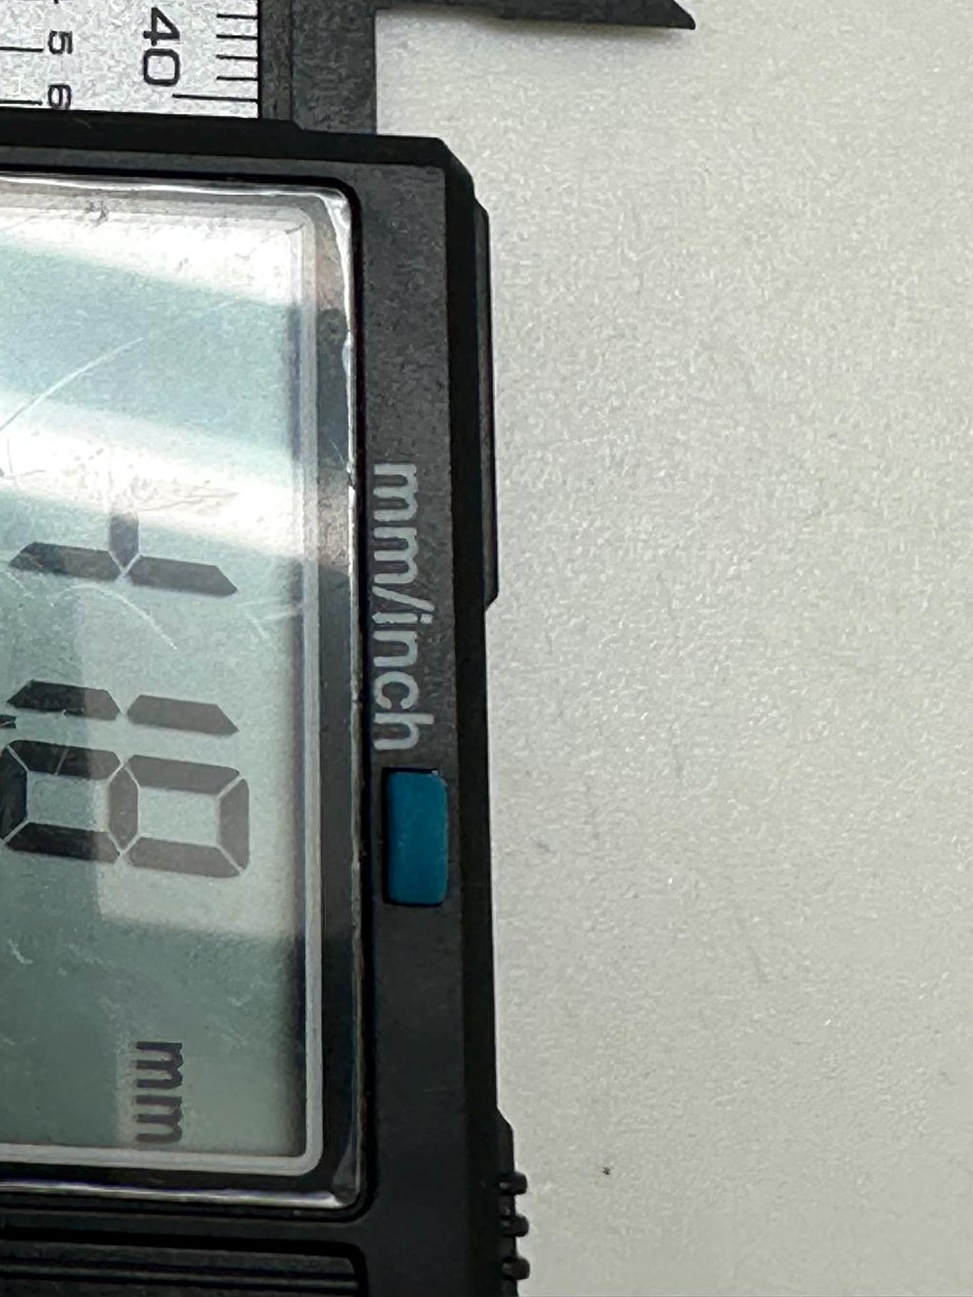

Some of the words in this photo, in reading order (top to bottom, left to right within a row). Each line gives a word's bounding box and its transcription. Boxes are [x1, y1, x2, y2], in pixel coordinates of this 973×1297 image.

[48, 30, 73, 55] 5
[143, 7, 181, 86] 40
[47, 84, 72, 110] 6
[372, 464, 434, 750] mm/inch
[133, 1041, 184, 1144] mm
